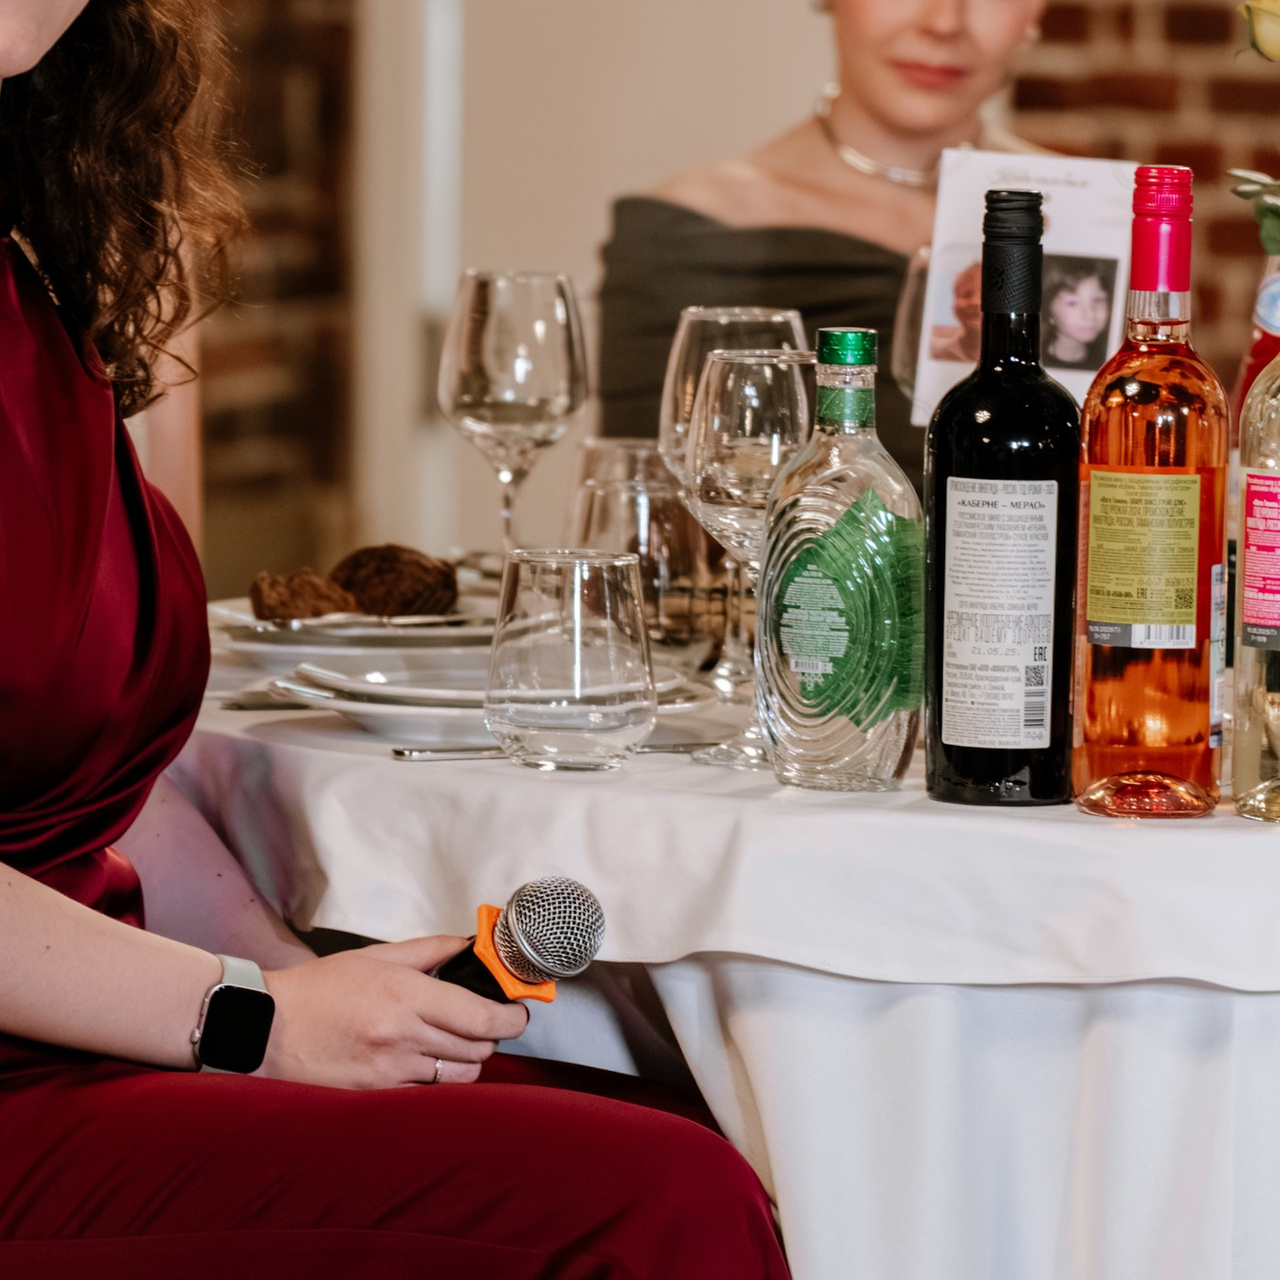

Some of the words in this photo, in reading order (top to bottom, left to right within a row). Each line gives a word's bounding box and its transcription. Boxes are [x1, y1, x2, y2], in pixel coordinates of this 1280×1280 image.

[958, 499, 1000, 509] «КАБЕРНЕ
[1010, 501, 1046, 510] МЕРЛО»
[972, 646, 1021, 656] 21.05.25.
[1034, 646, 1047, 661] EAC
